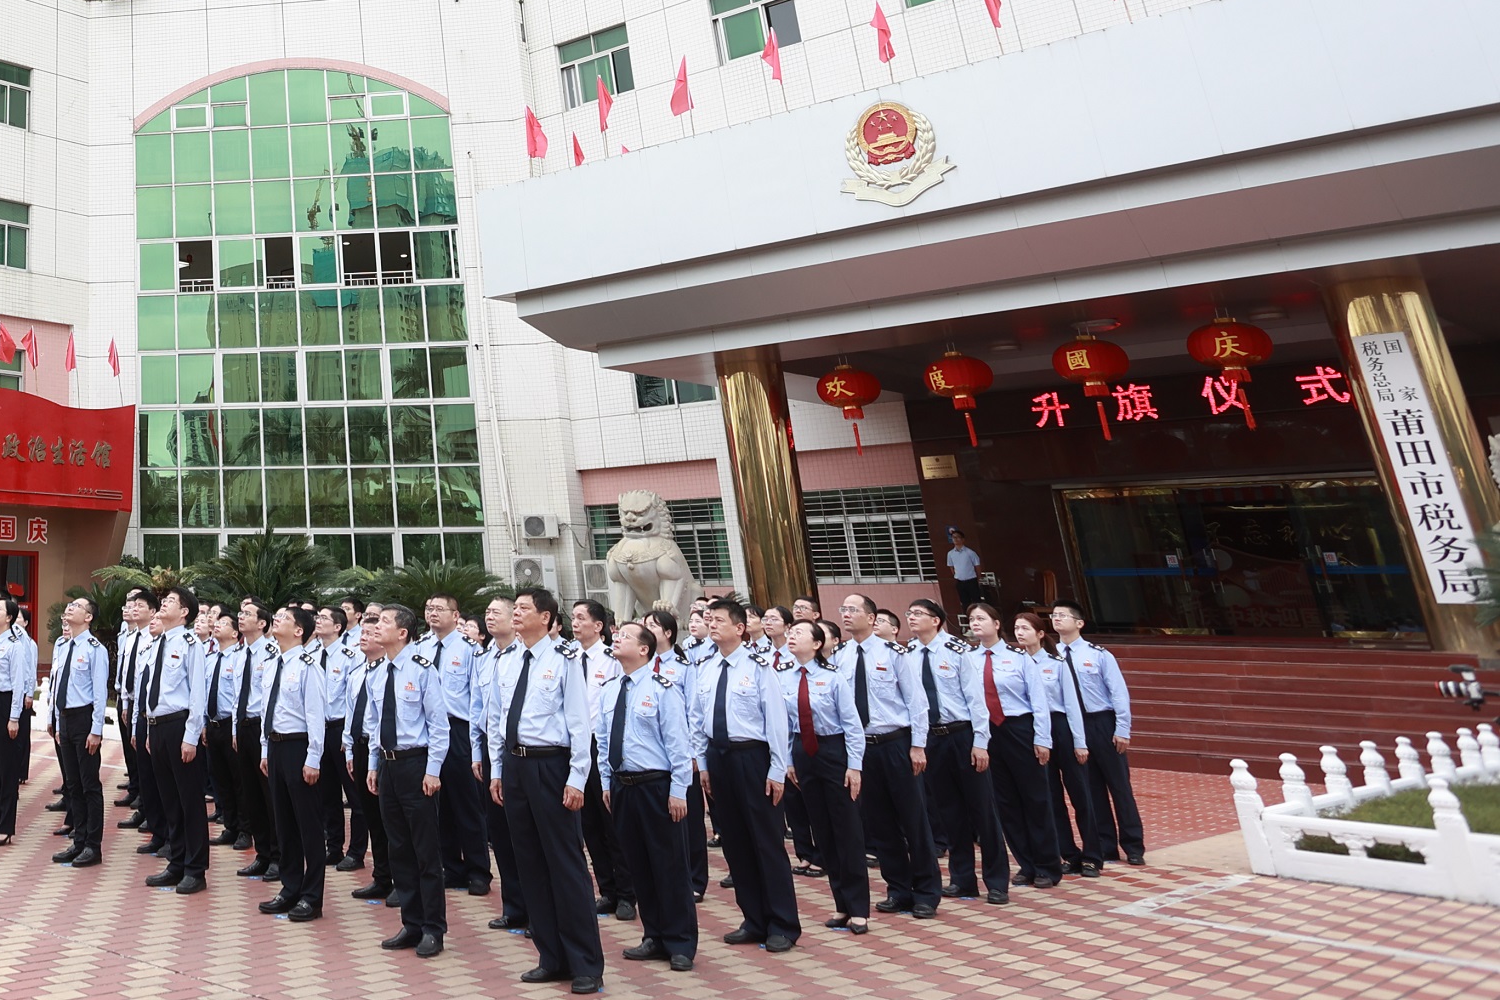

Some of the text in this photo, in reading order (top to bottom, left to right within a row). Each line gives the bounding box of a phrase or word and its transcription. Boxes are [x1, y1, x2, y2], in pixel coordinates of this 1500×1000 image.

[1031, 365, 1350, 428] 升旗仪式
[1383, 408, 1481, 597] 莆田市税务局
